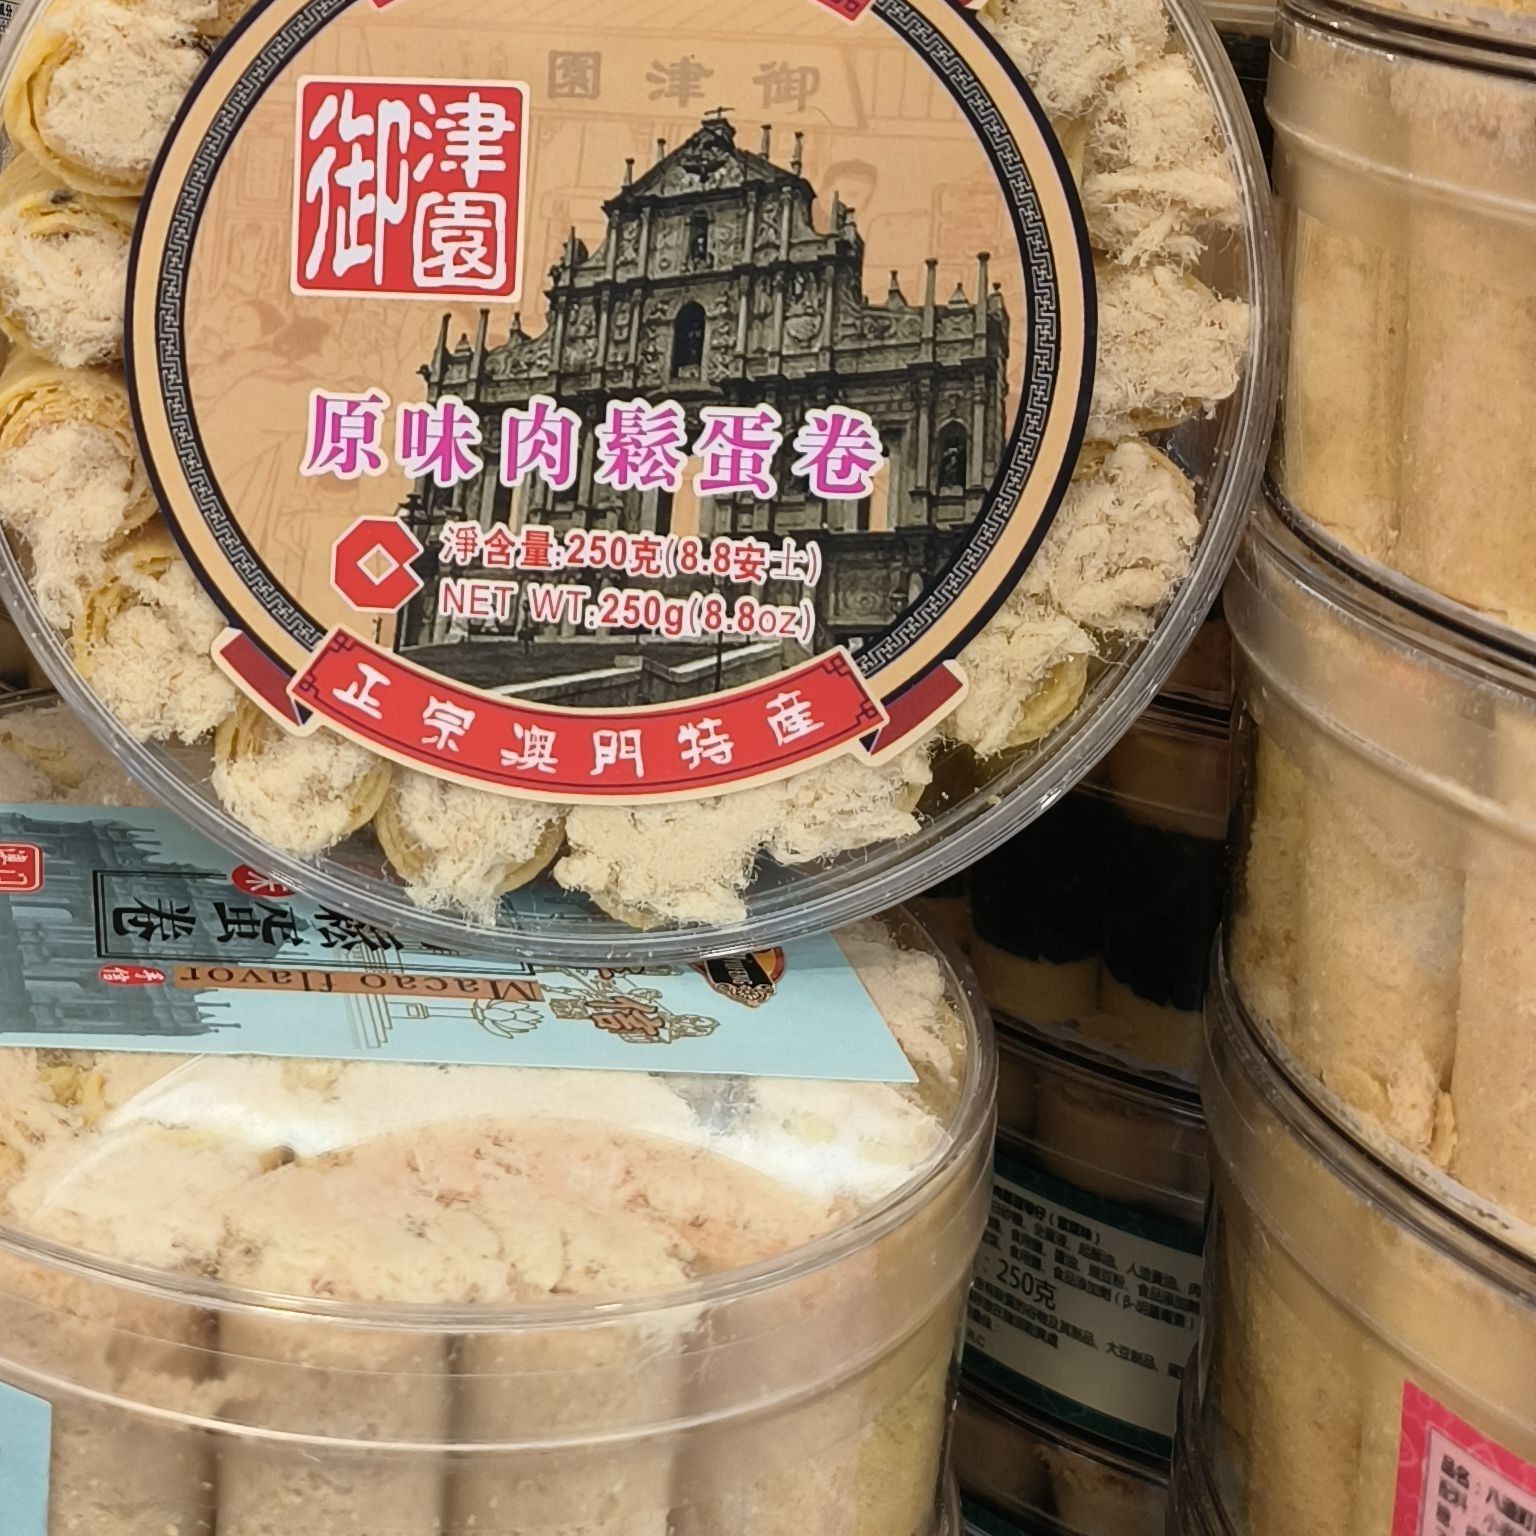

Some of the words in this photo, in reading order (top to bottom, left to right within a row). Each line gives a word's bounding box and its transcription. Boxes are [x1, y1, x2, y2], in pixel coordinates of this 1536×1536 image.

[300, 387, 885, 500] 原味肉鬆蛋卷
[440, 581, 512, 621] NET
[333, 664, 826, 778] 正宗澳門特產
[177, 965, 332, 993] flavor
[359, 973, 538, 1002] Macao
